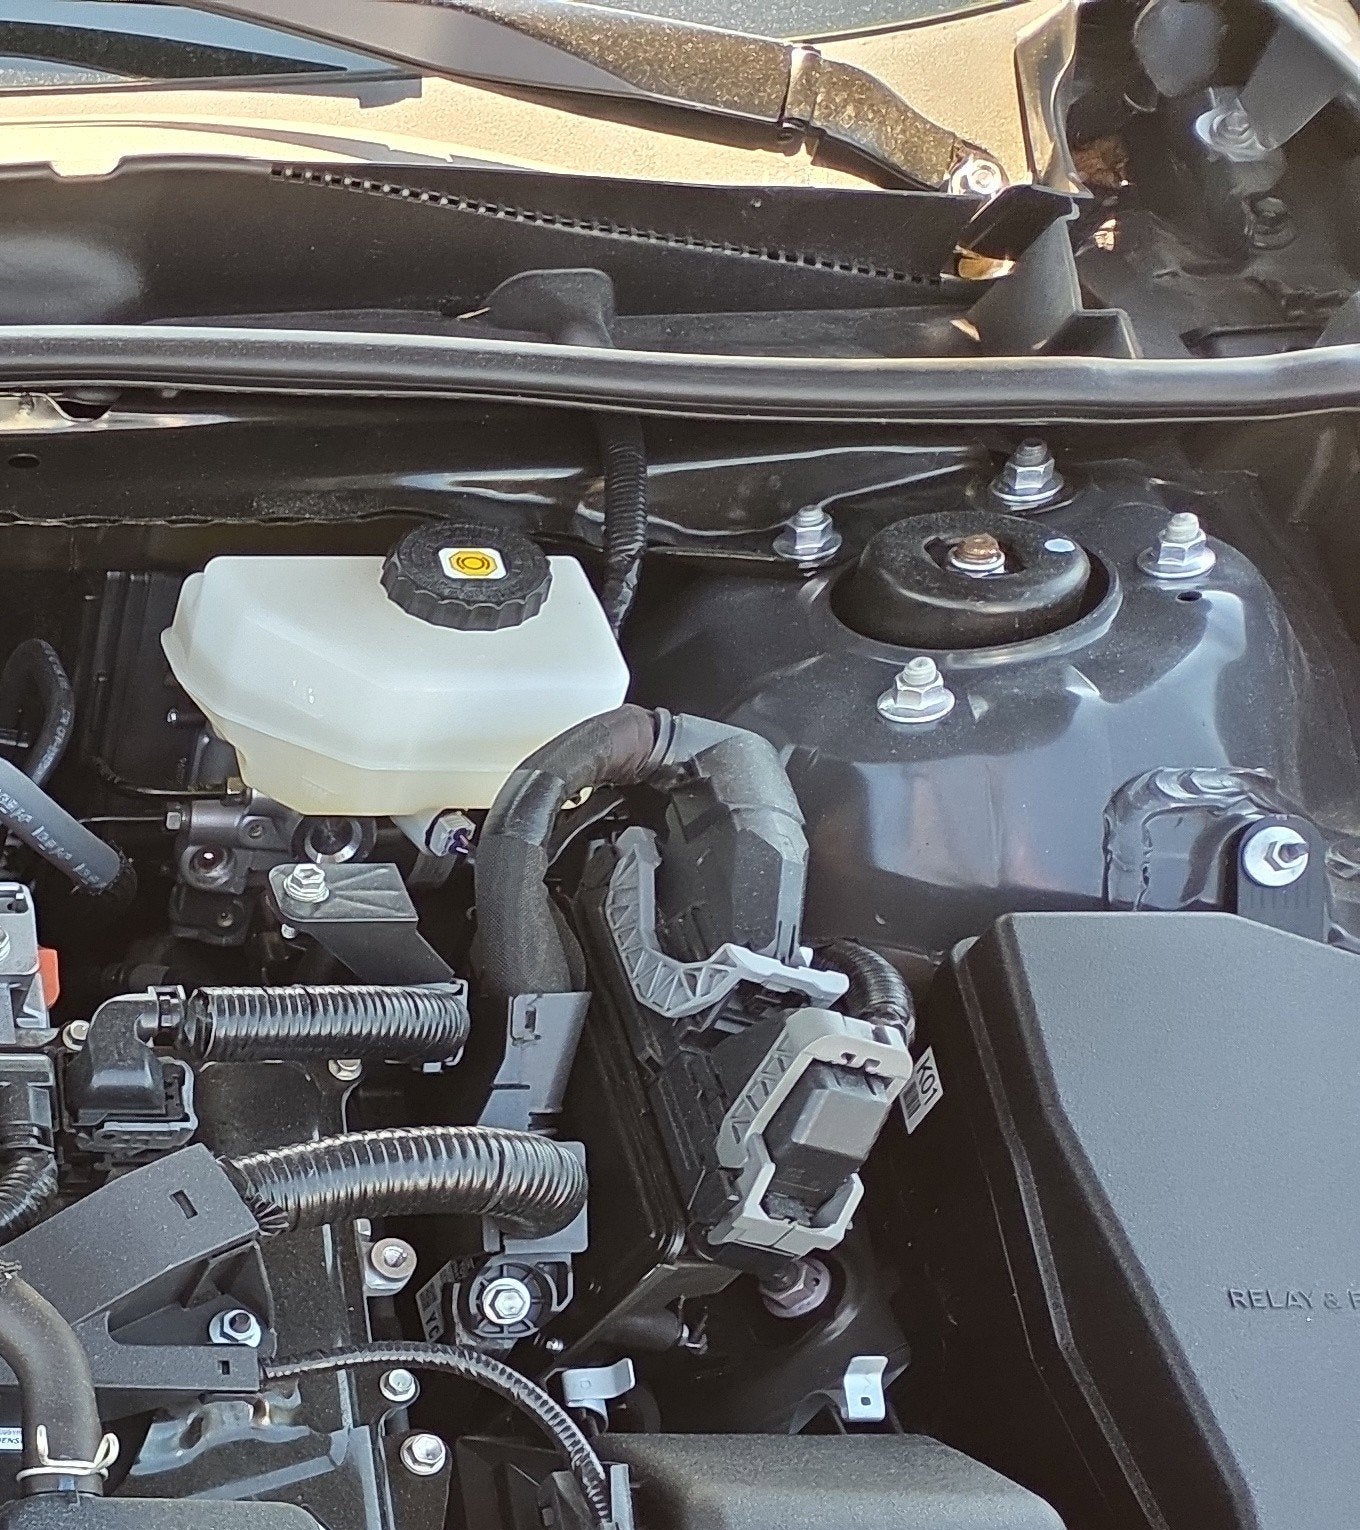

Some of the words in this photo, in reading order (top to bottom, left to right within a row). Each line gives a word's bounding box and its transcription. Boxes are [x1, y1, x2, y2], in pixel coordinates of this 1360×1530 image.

[917, 1056, 938, 1105] K01
[1226, 1288, 1314, 1309] RELAY
[1322, 1292, 1342, 1309] &
